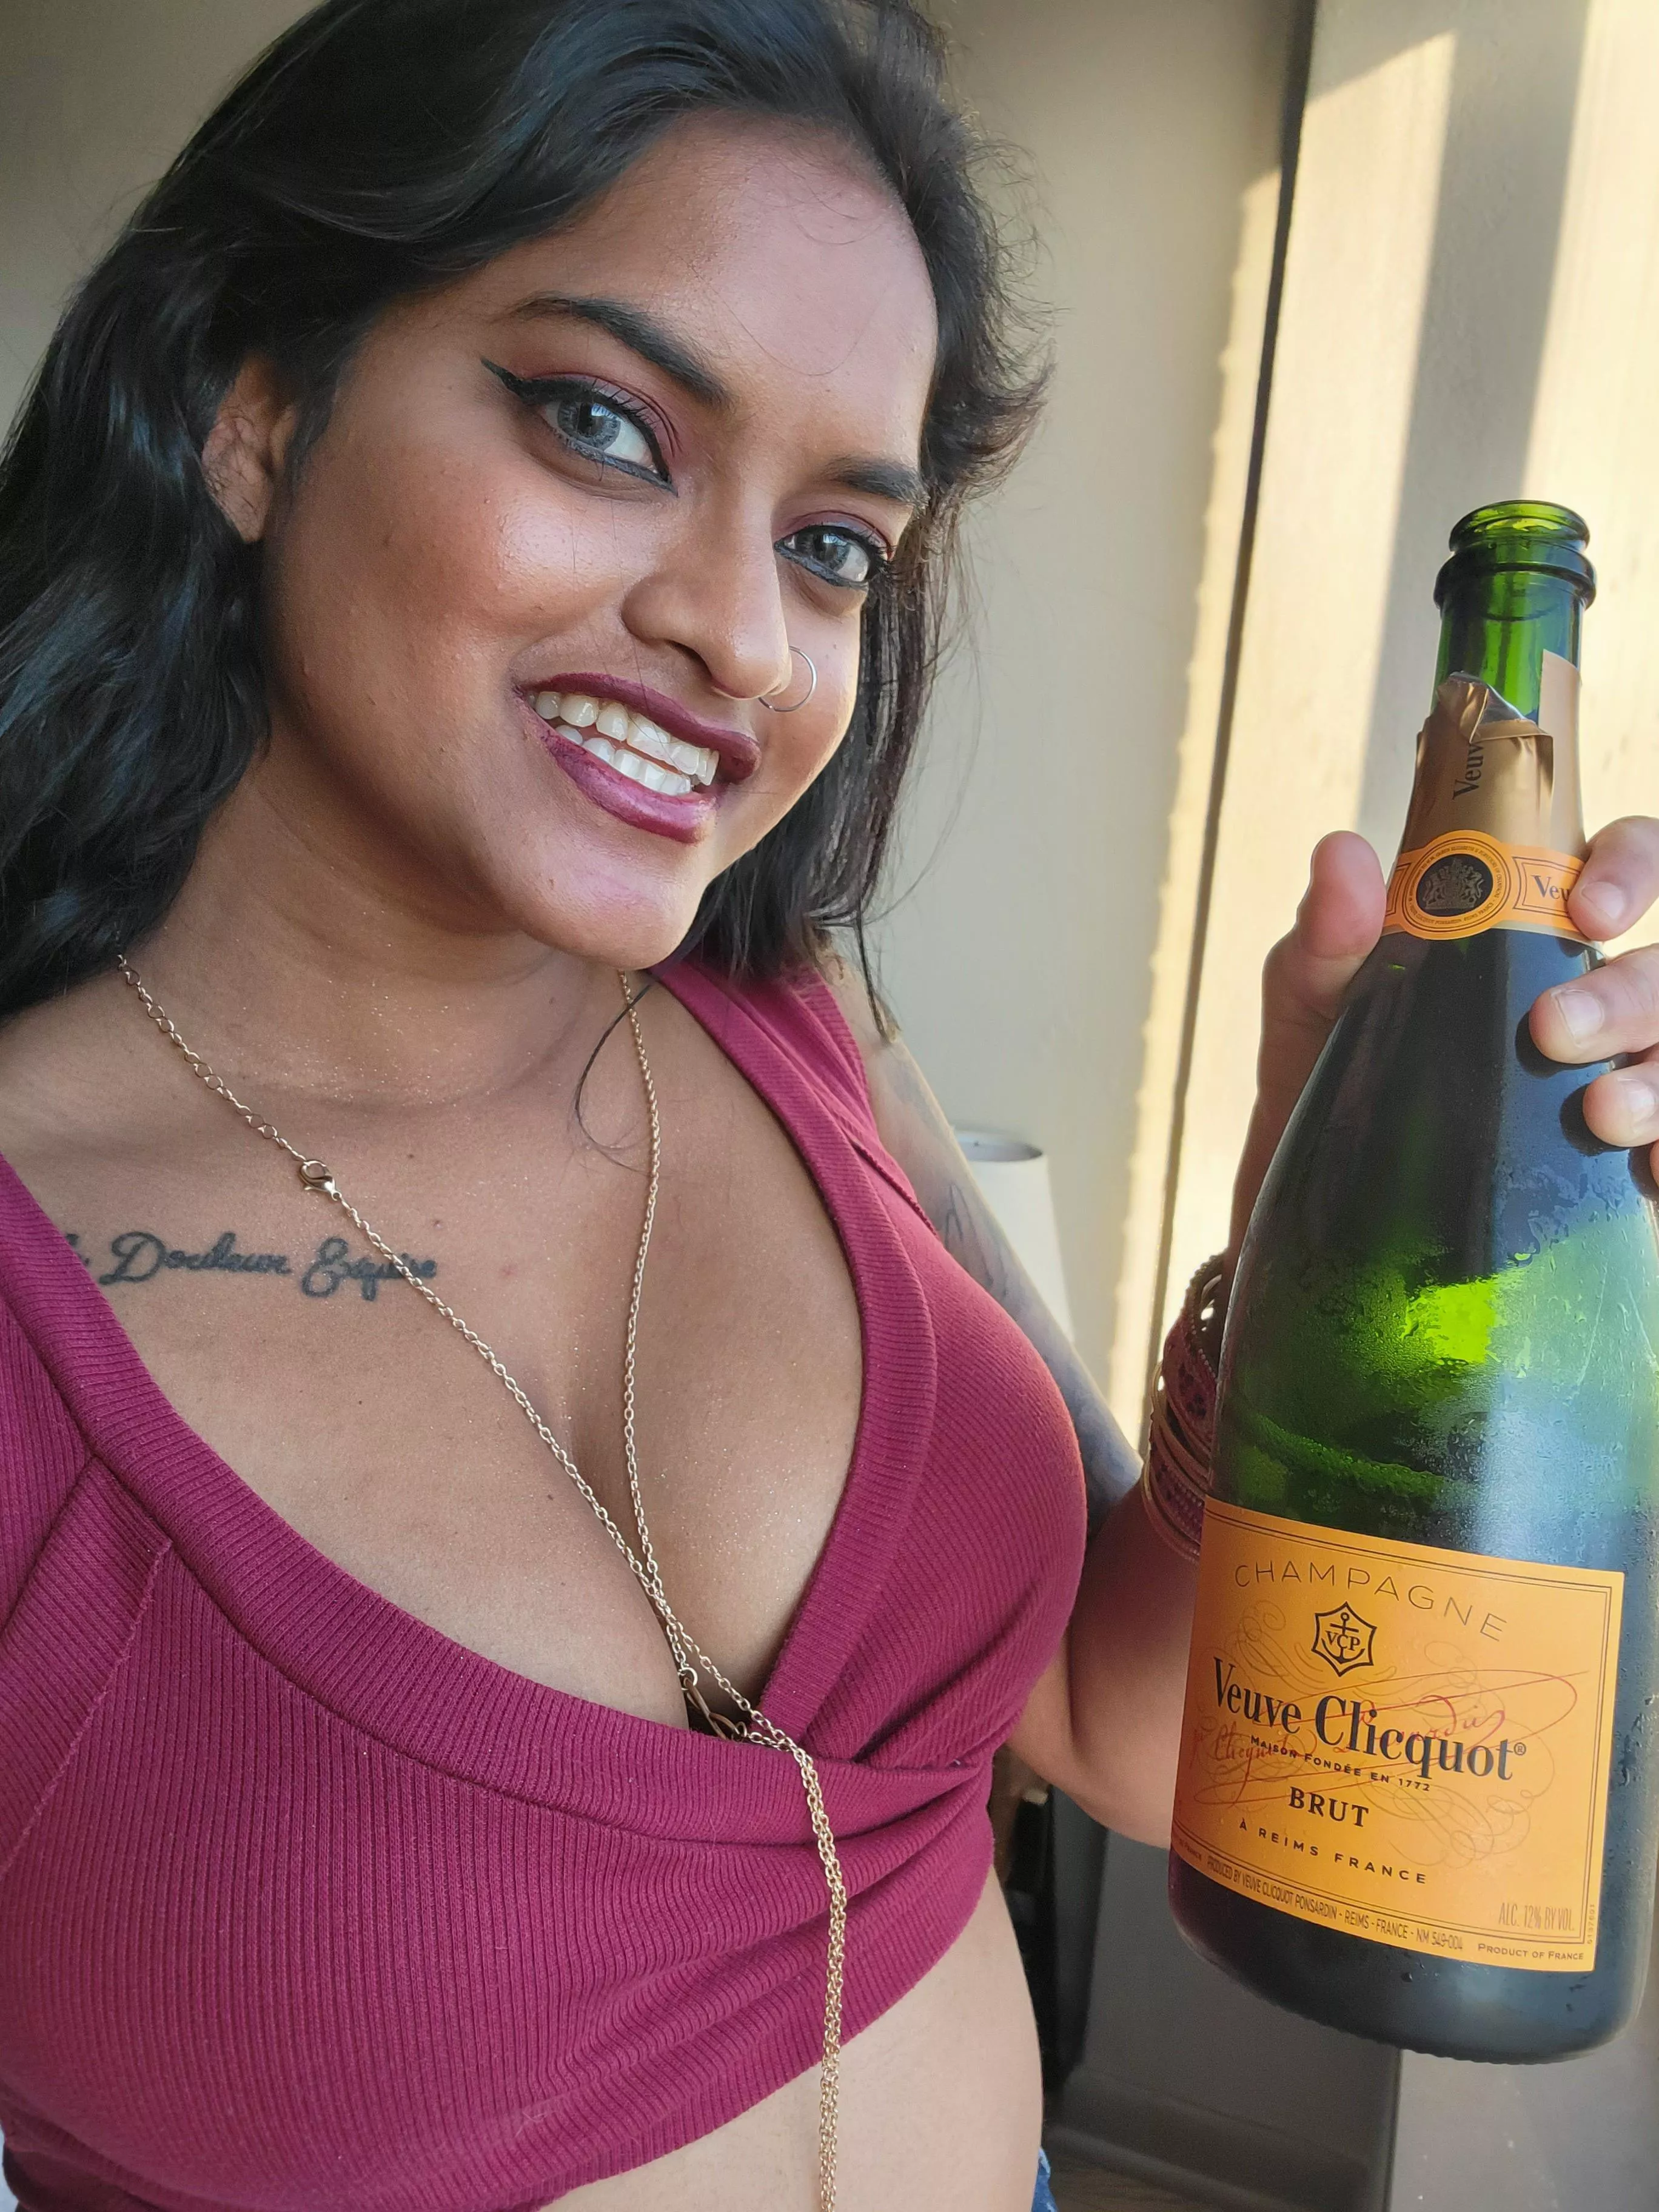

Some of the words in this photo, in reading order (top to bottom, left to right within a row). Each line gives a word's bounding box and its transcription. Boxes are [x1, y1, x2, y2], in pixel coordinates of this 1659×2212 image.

[1234, 1560, 1508, 1643] CHAMPAGNE
[1324, 1629, 1361, 1652] VCP
[1213, 1656, 1302, 1734] Veuve
[1251, 1734, 1298, 1758] MAISON
[1304, 1753, 1362, 1777] FONDÉE
[1370, 1772, 1389, 1783] EN
[1399, 1778, 1430, 1792] 1772
[1289, 1786, 1369, 1828] BRUT
[1239, 1817, 1248, 1831] À
[1258, 1828, 1319, 1857] REIMS
[1334, 1852, 1426, 1884] FRANCE
[1207, 1855, 1233, 1880] PRODUCED
[1233, 1869, 1242, 1884] BY
[1242, 1873, 1261, 1894] VEUVE
[1262, 1880, 1294, 1905] CLICQUOT
[1295, 1894, 1338, 1920] PONSARDIN
[1344, 1909, 1370, 1929] REIMS
[1376, 1919, 1409, 1940] FRANCE
[1416, 1928, 1429, 1944] NM
[1498, 1902, 1520, 1928] ALC.
[1524, 1905, 1542, 1929] 12%
[1545, 1907, 1557, 1931] BY
[1477, 1943, 1529, 1958] PRODUCT
[1547, 1950, 1584, 1960] FRANCE
